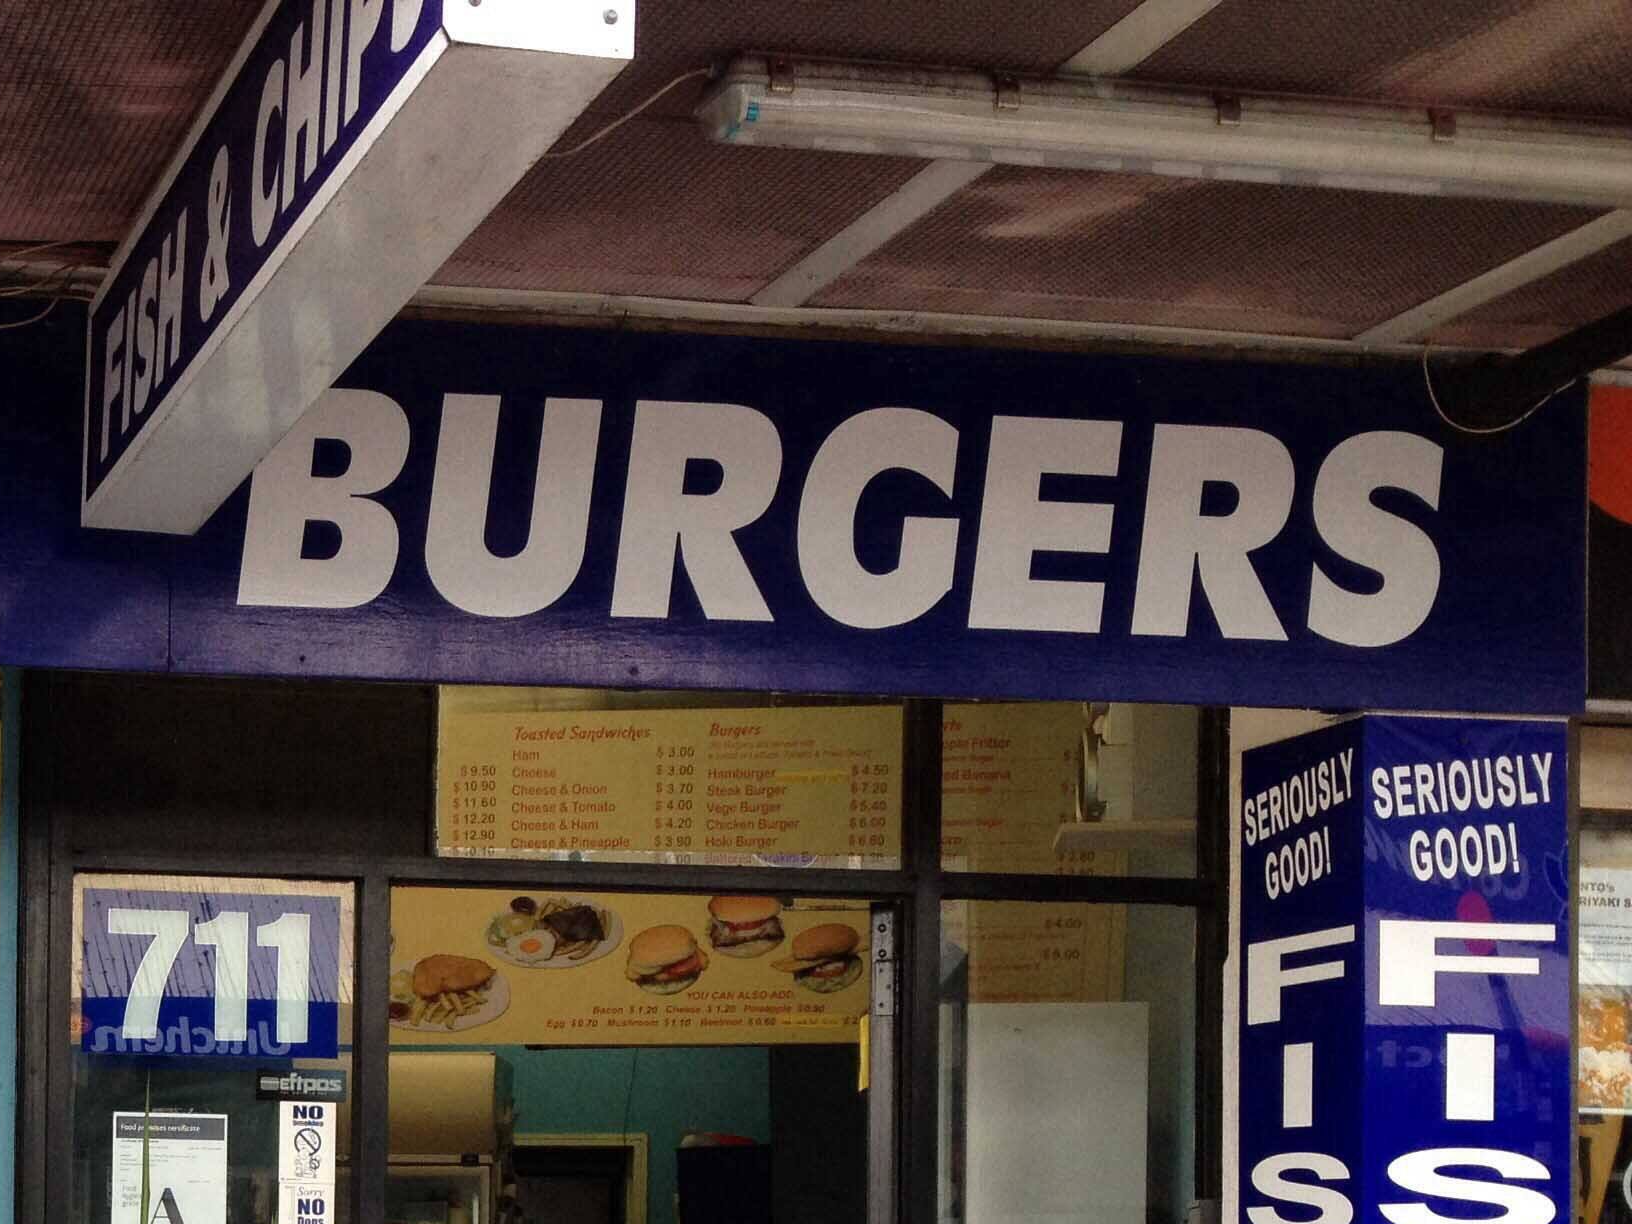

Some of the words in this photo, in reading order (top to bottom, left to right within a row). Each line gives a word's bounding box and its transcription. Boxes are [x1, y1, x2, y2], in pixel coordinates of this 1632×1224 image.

[100, 207, 186, 463] FISH
[200, 145, 231, 323] &
[236, 388, 1444, 647] BURGERS
[514, 726, 566, 741] Toasted
[570, 725, 651, 743] Sandwiches
[710, 723, 761, 738] Burgers
[512, 750, 540, 761] Ham
[572, 783, 608, 795] Onion
[1371, 752, 1553, 820] SERIOUSLY
[1244, 748, 1354, 847] SERIOUSLY
[573, 800, 616, 813] Tomato
[571, 818, 599, 831] Ham
[1409, 822, 1519, 882] GOOD!
[1265, 826, 1332, 901] GOOD!
[108, 908, 311, 1043] 711
[687, 990, 709, 1000] YOU
[711, 990, 736, 1000] CAN
[738, 990, 768, 1000] ALSO
[279, 1072, 343, 1094] eftpos
[293, 1105, 324, 1120] NO
[121, 1124, 137, 1132] Food
[168, 1124, 201, 1132] certificate
[297, 1186, 325, 1199] Sorry
[297, 1199, 325, 1215] NO
